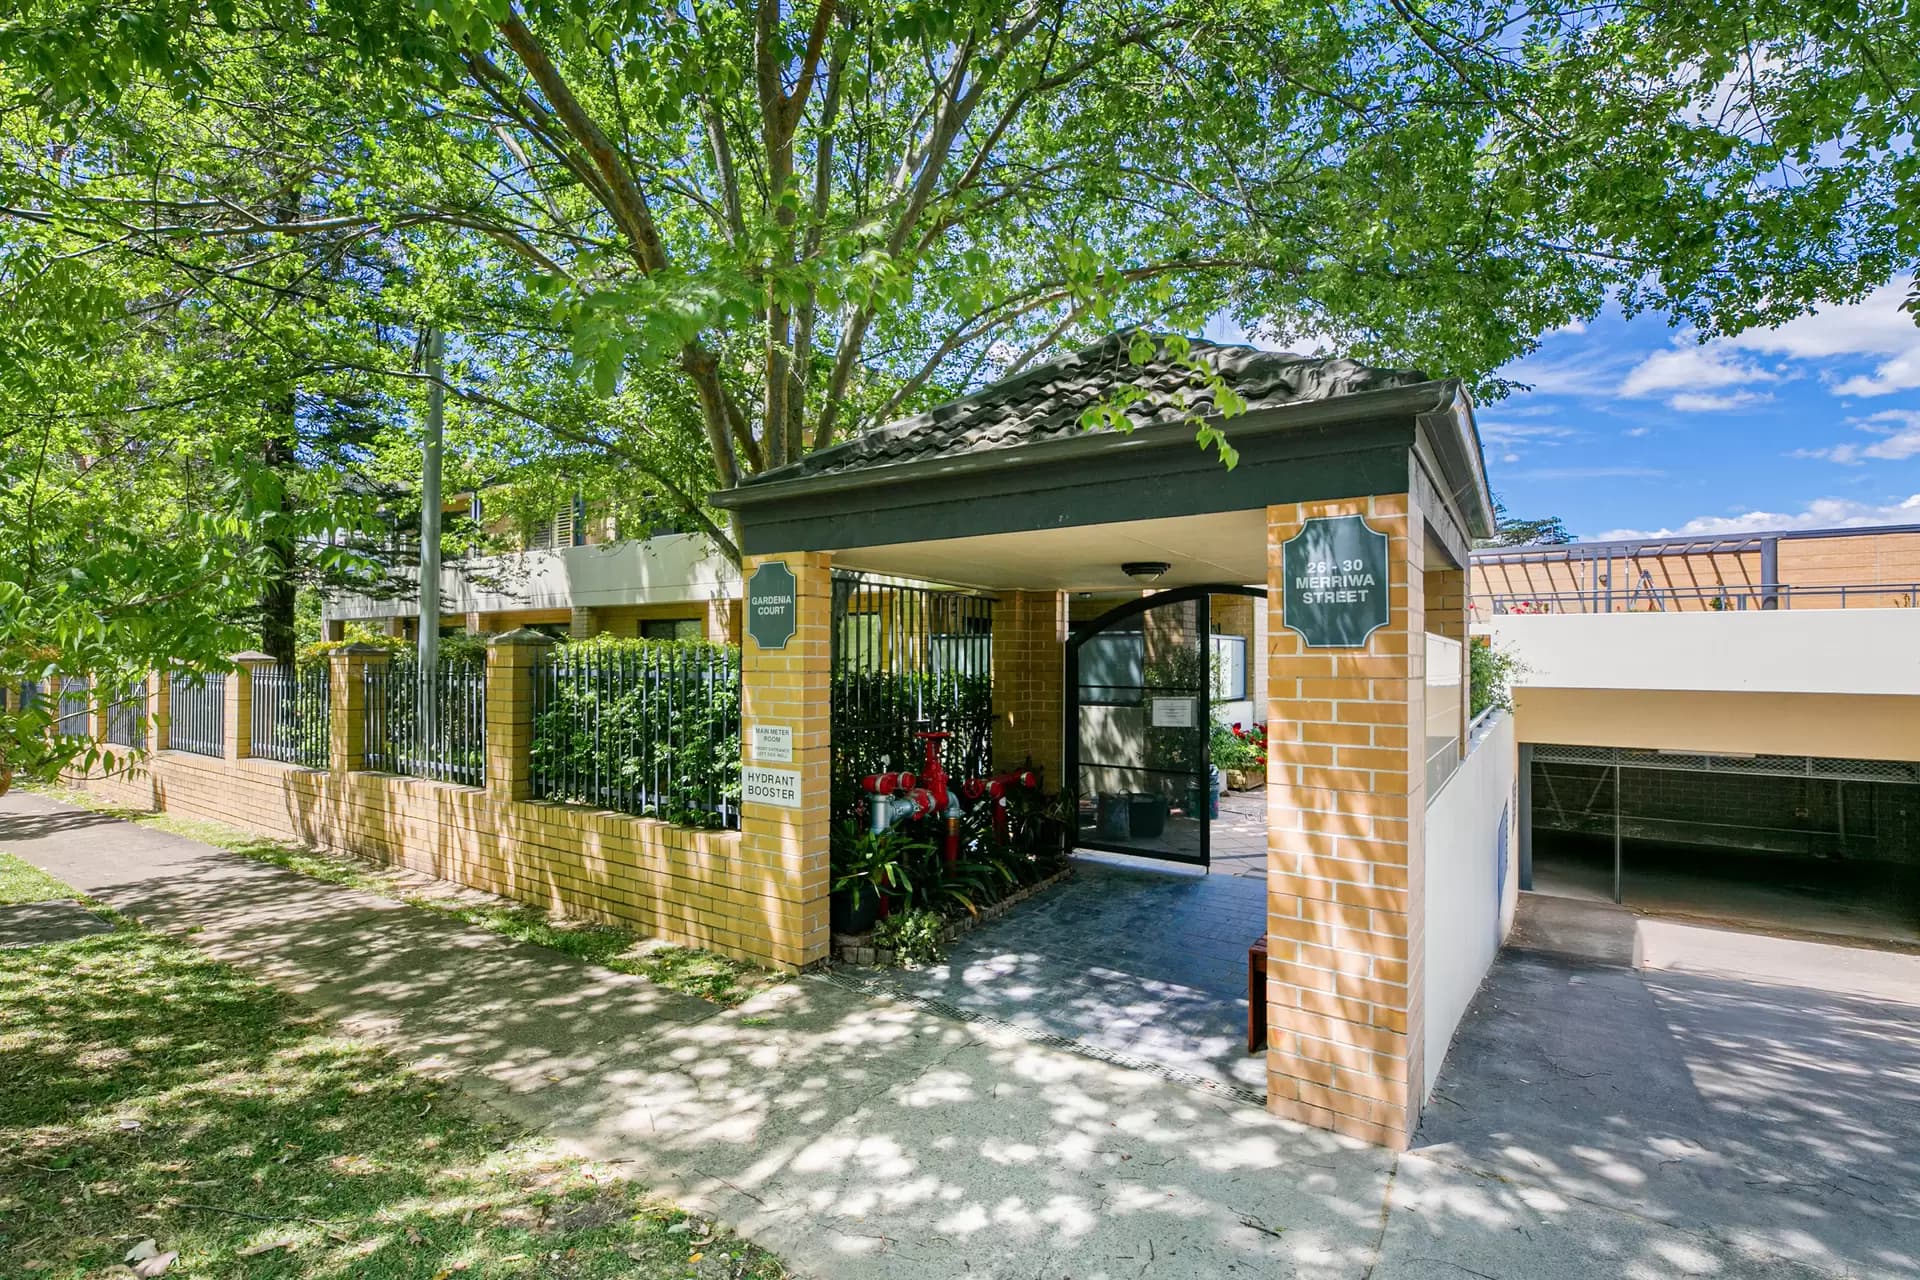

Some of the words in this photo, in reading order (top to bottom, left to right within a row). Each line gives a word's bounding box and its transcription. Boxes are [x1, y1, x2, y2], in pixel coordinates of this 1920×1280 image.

[1307, 561, 1326, 573] 26
[1343, 559, 1363, 571] 30
[1295, 574, 1375, 589] MERRIWA
[751, 595, 792, 605] GARDENIA
[1302, 590, 1369, 604] STREET
[758, 606, 785, 615] COURT
[770, 728, 790, 736] METER
[748, 772, 795, 786] HYDRANT
[748, 785, 795, 800] BOOSTER
